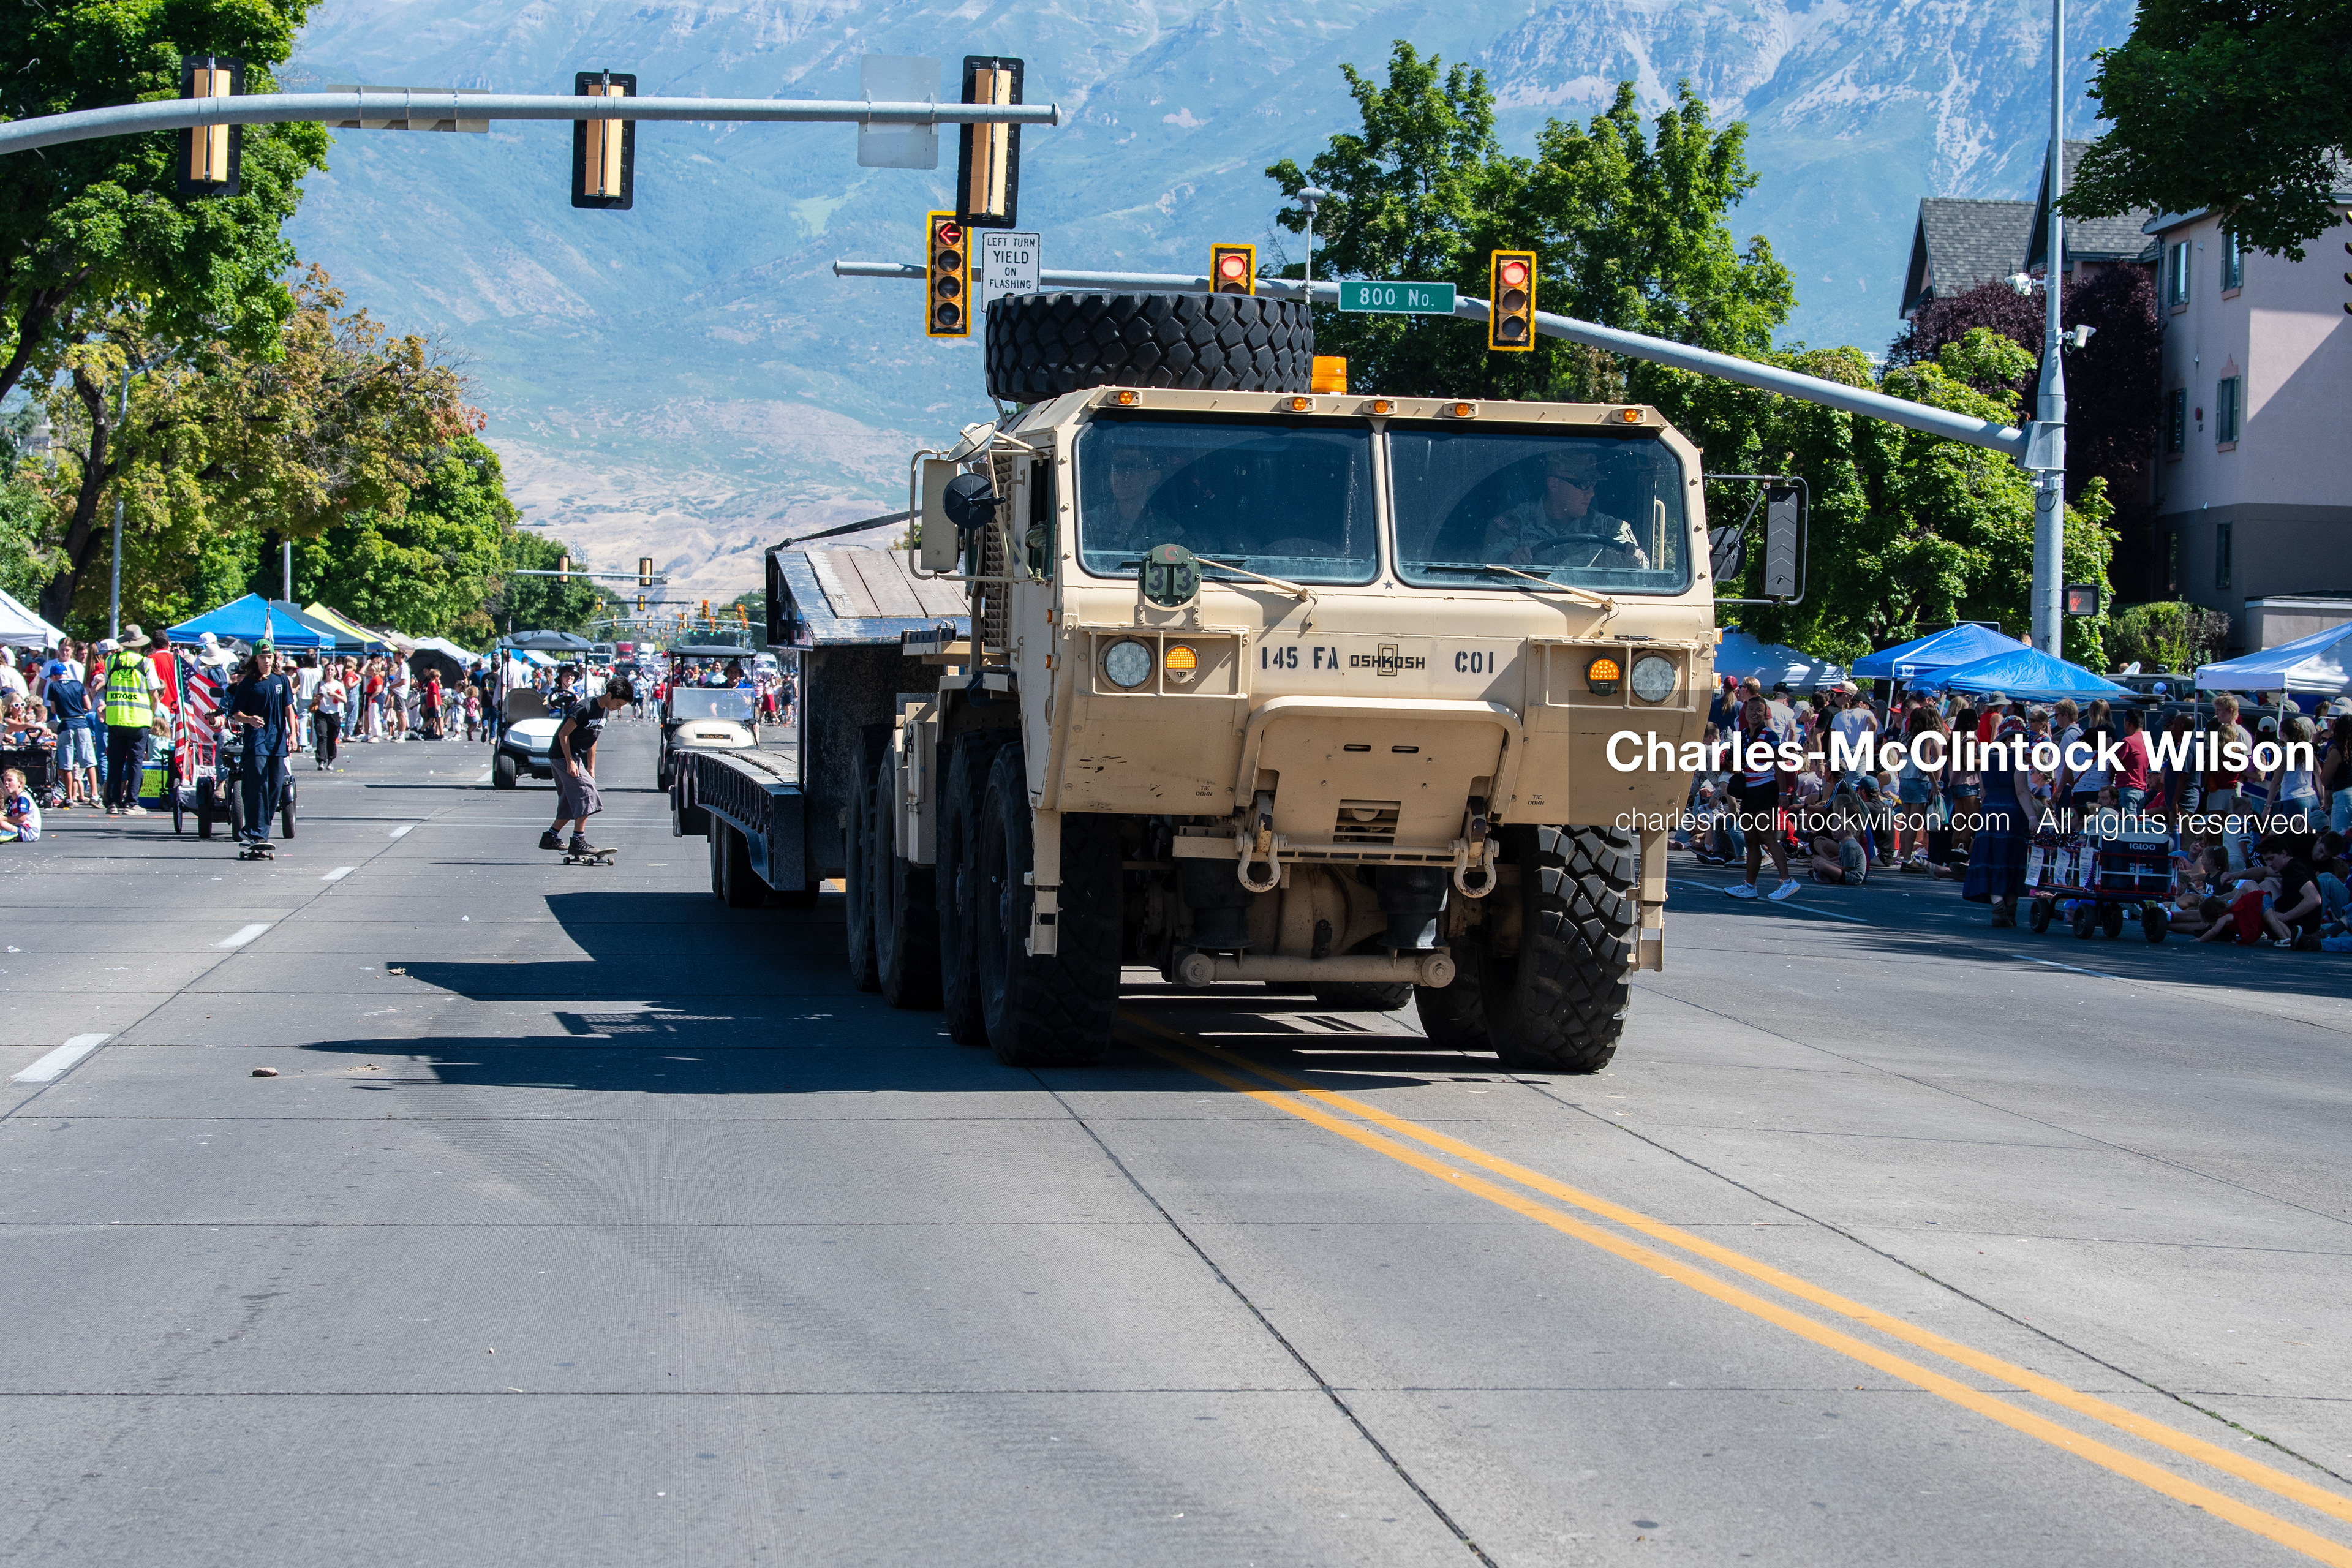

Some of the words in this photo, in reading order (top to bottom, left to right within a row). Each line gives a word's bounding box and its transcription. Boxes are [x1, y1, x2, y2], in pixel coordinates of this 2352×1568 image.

[987, 238, 1007, 246] LEFT
[1014, 238, 1035, 247] TURN
[993, 250, 1028, 264] YIELD
[1005, 267, 1016, 276] ON
[990, 279, 1031, 289] FLASHING
[1360, 288, 1395, 305] 800
[1408, 289, 1434, 307] No.
[1164, 546, 1177, 561] C
[1262, 646, 1298, 669] 145
[1313, 647, 1339, 669] FA
[1350, 654, 1425, 670] OSHKOSH
